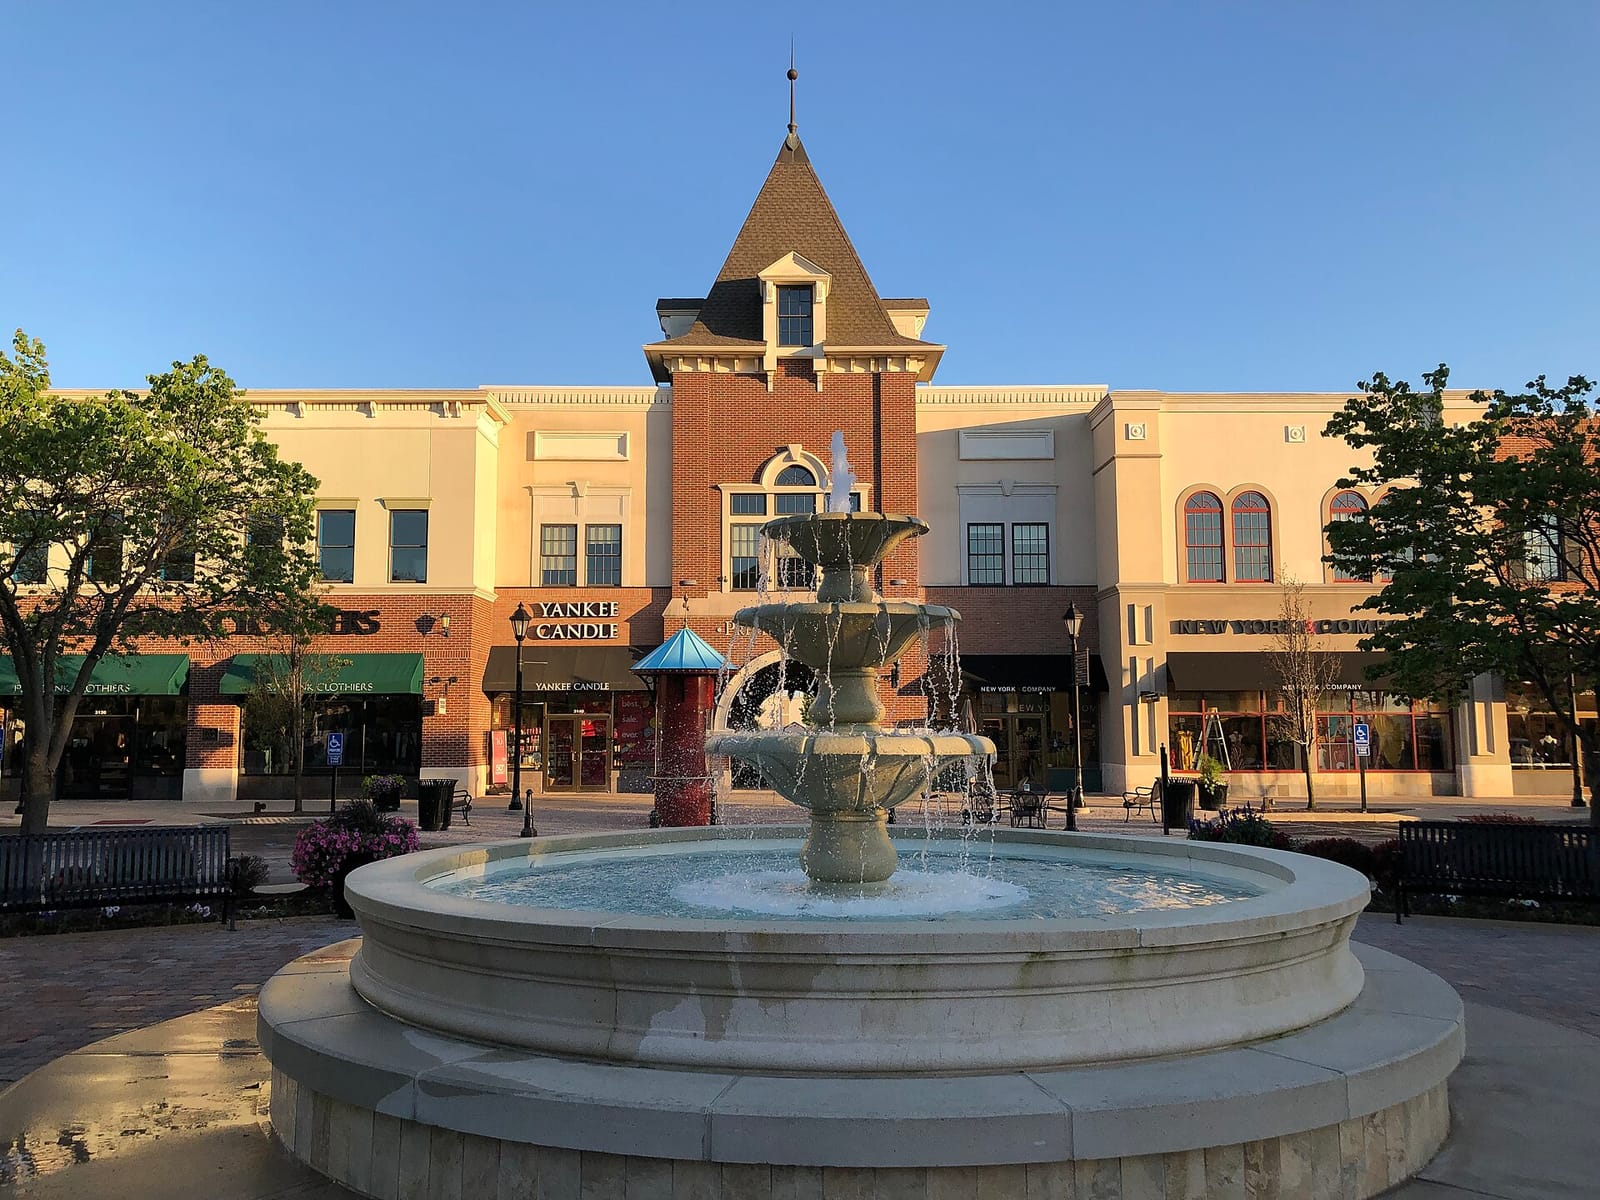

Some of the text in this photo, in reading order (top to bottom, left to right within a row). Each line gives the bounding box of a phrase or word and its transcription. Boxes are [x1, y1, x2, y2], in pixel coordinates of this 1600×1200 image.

[540, 601, 619, 617] YANKEE
[536, 623, 619, 639] CANDLE
[1180, 620, 1228, 634] NEW
[84, 683, 131, 693] OTHIERS
[316, 682, 374, 692] CLOTHIERS
[535, 682, 610, 691] YANKEE CANDLE
[1326, 683, 1363, 691] COMPANY
